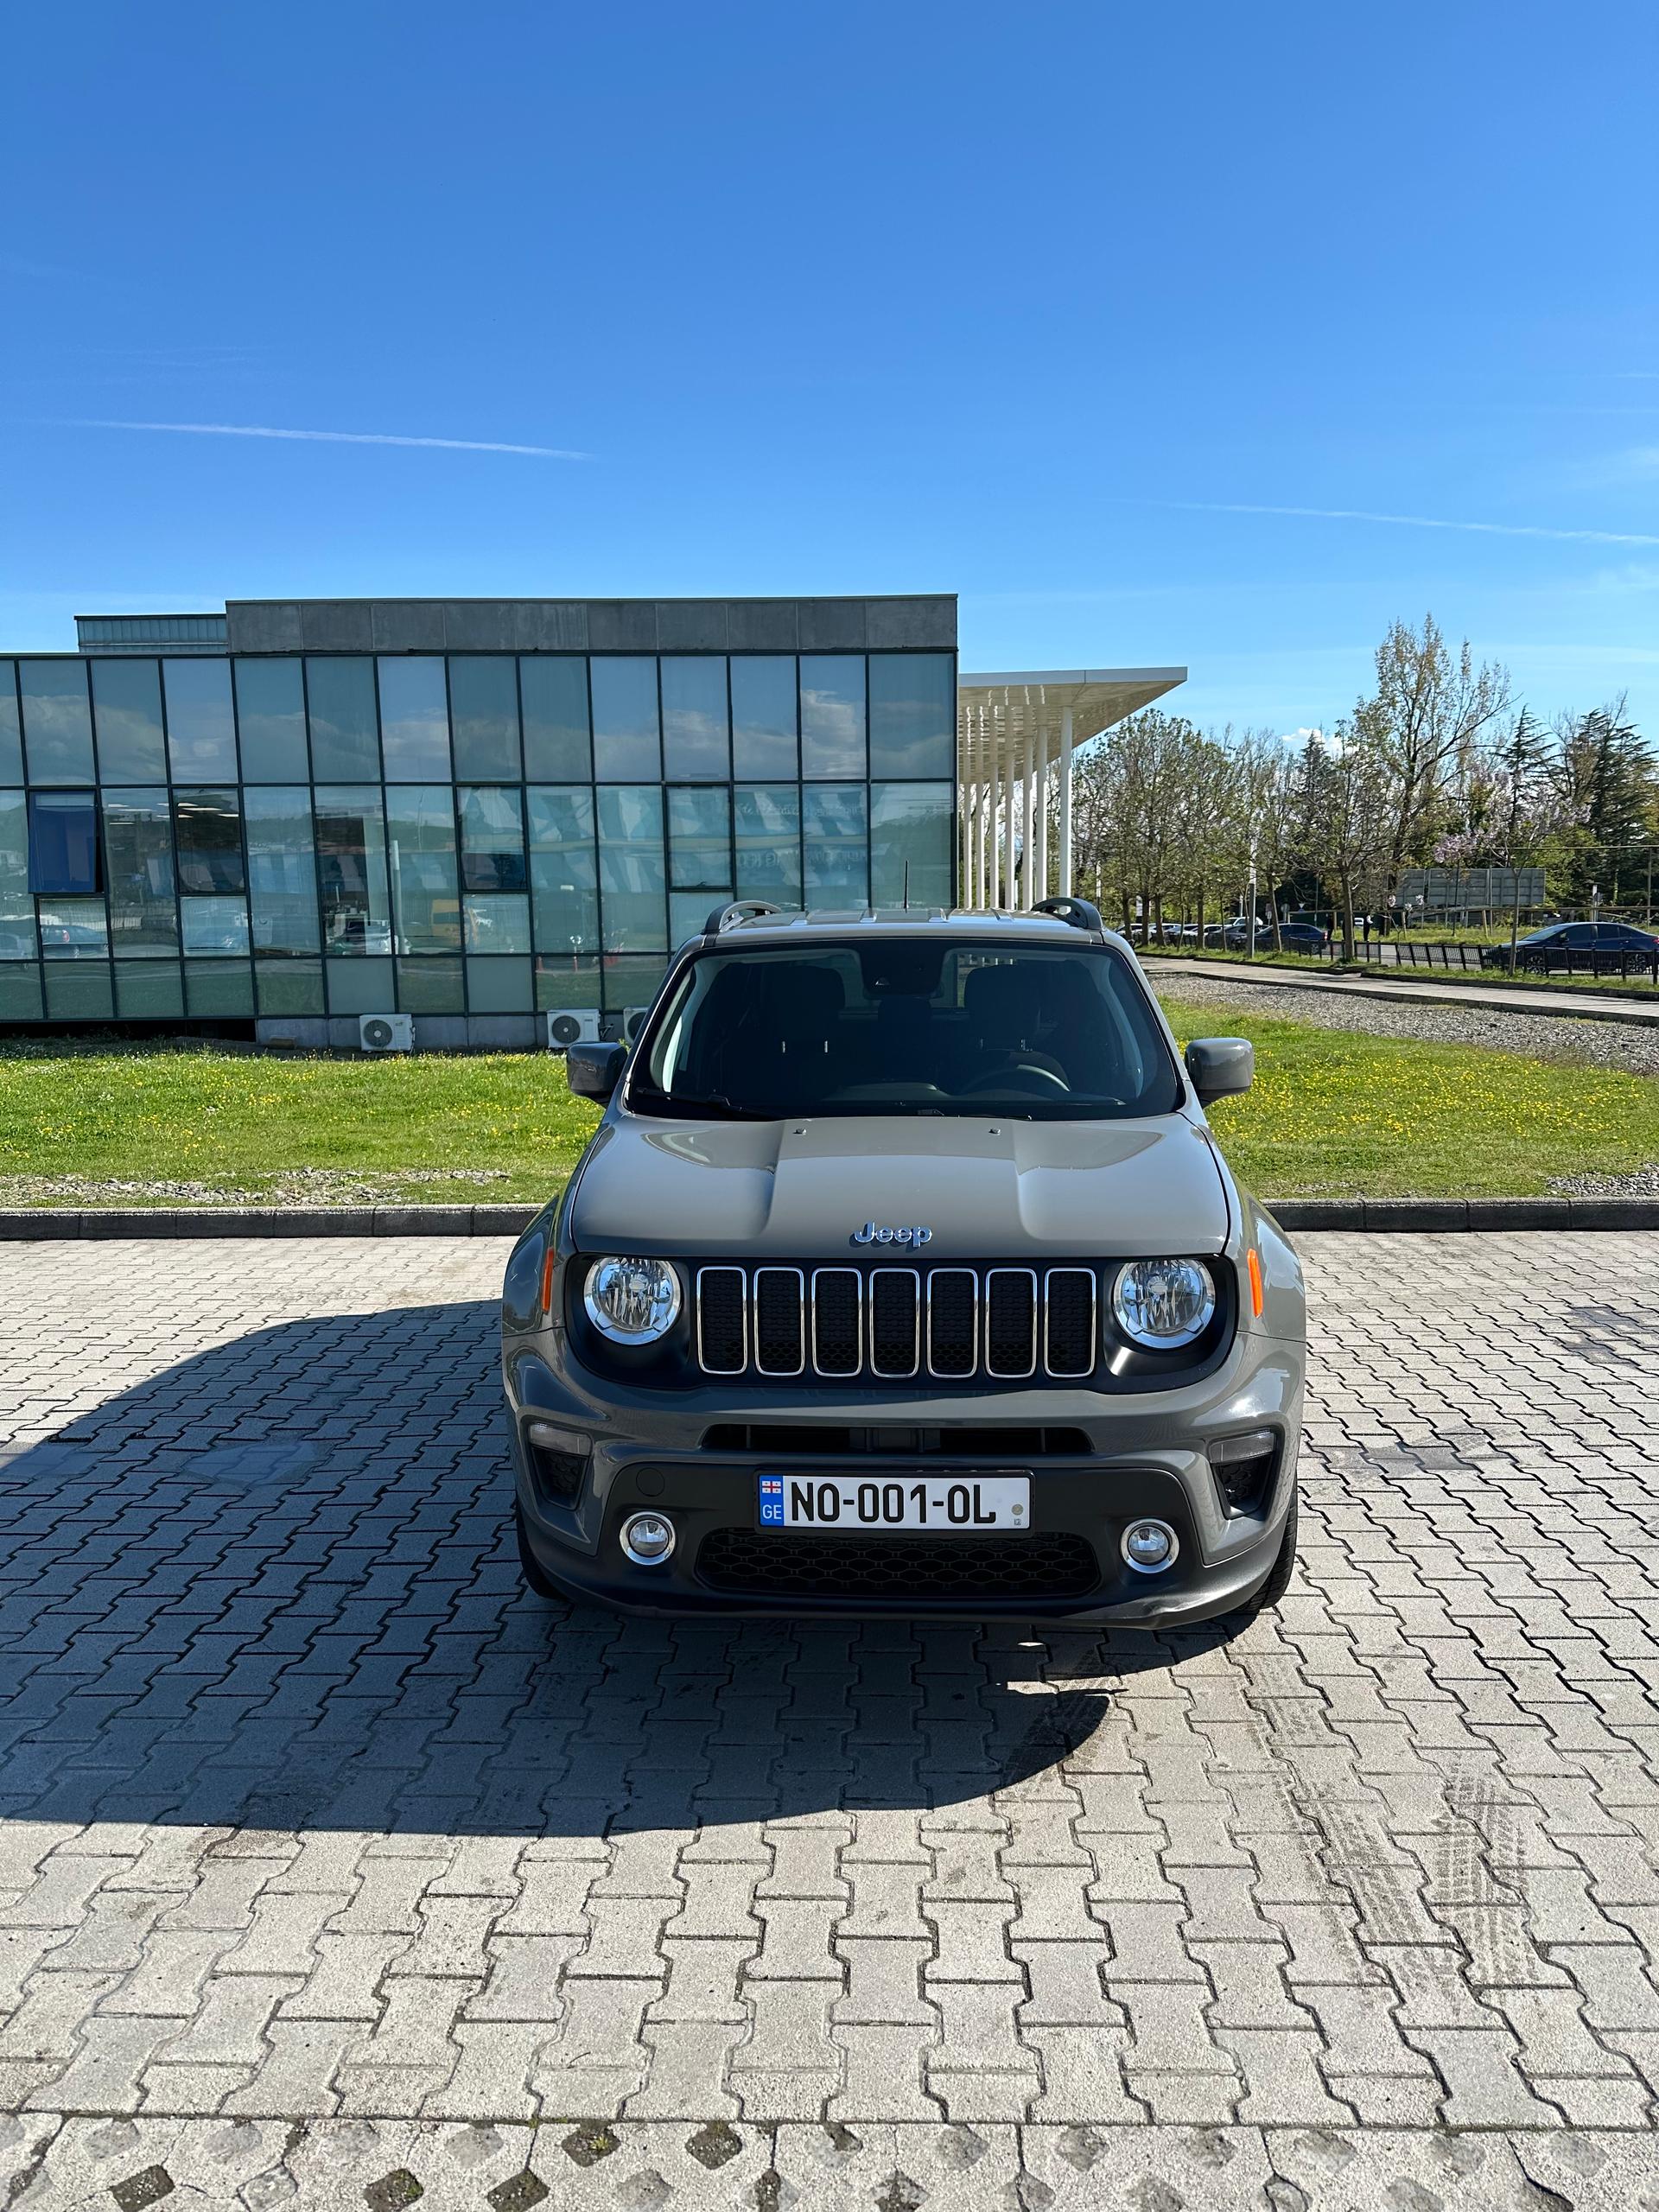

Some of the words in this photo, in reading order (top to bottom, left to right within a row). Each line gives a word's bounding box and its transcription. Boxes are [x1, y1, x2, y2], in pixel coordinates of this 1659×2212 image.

[854, 1221, 933, 1248] Jeep
[762, 1503, 782, 1520] GE
[791, 1481, 997, 1524] NO-001-OL
